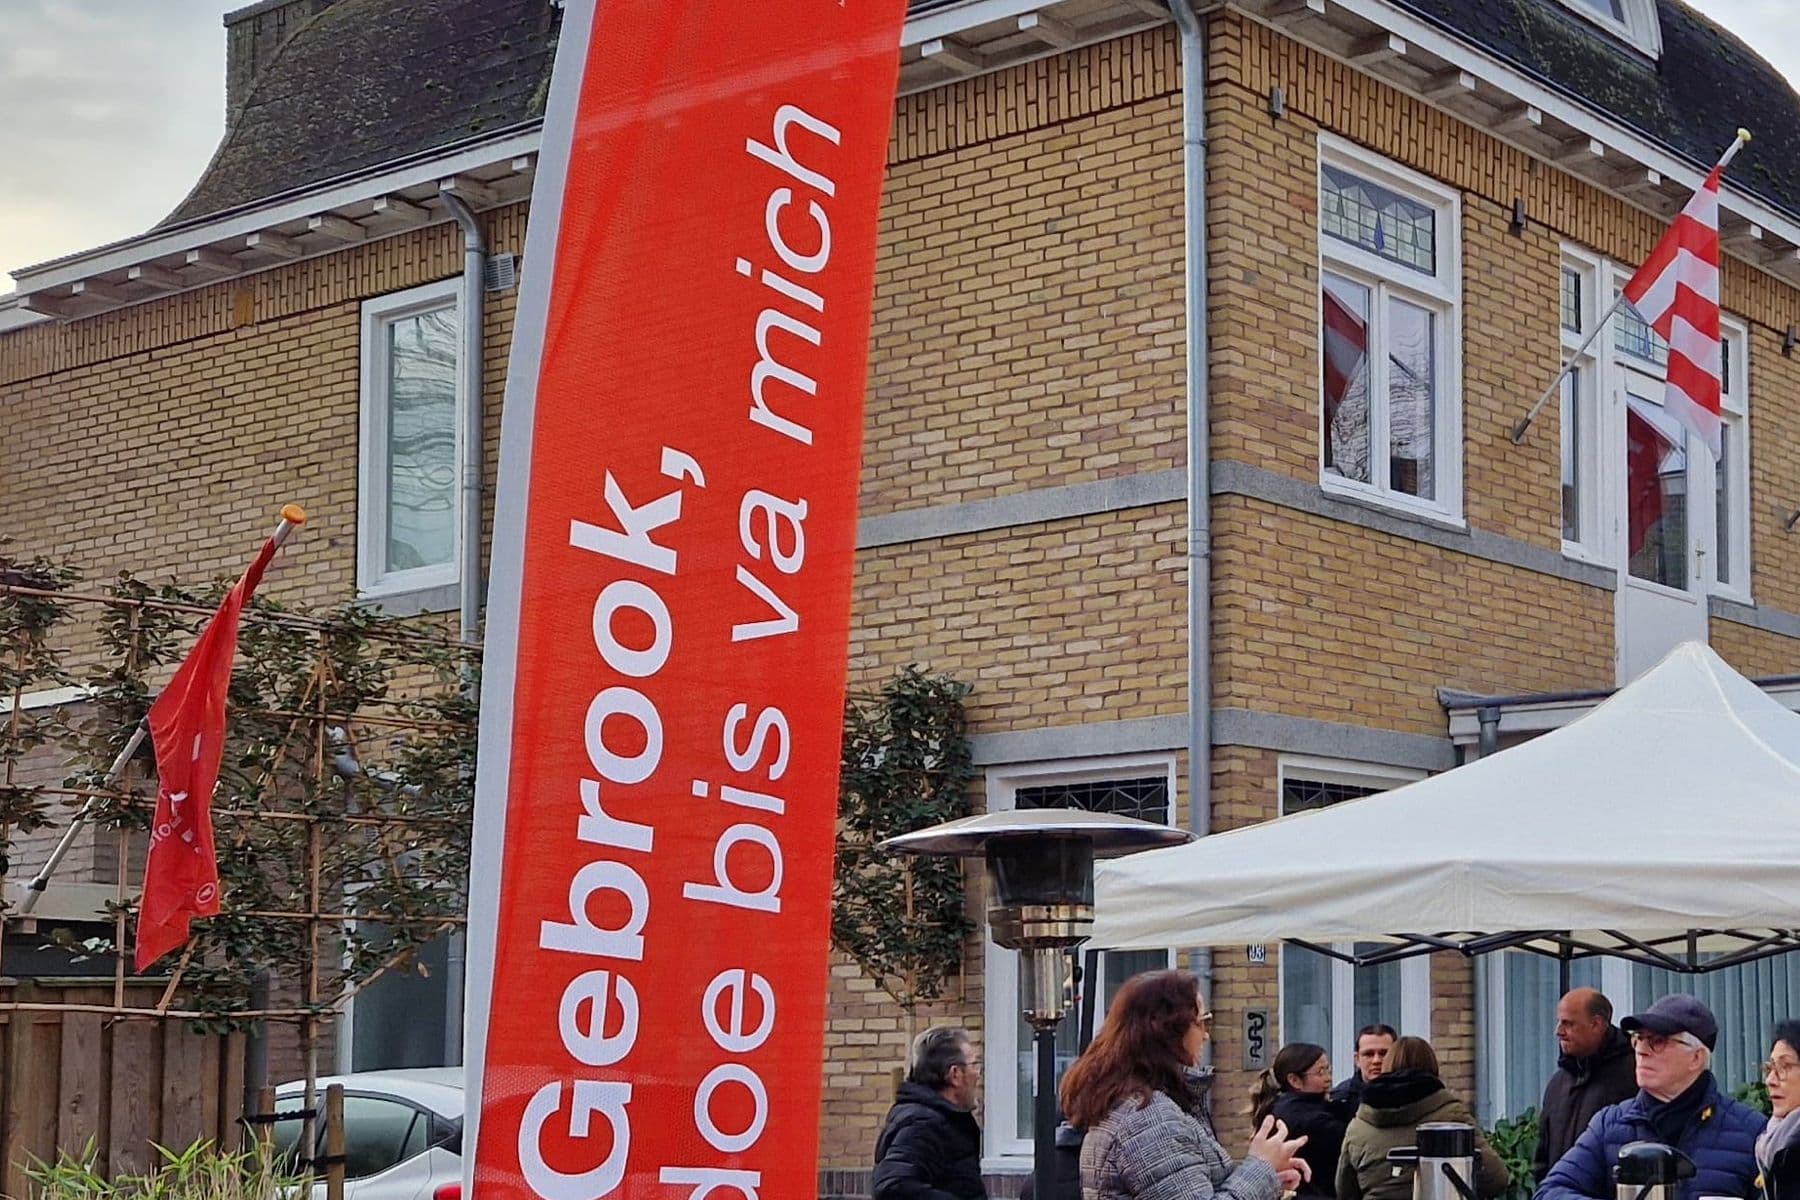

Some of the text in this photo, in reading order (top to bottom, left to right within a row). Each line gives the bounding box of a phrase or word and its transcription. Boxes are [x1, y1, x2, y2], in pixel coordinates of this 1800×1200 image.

[735, 104, 841, 445] mich
[732, 489, 808, 642] va
[684, 703, 790, 913] bis
